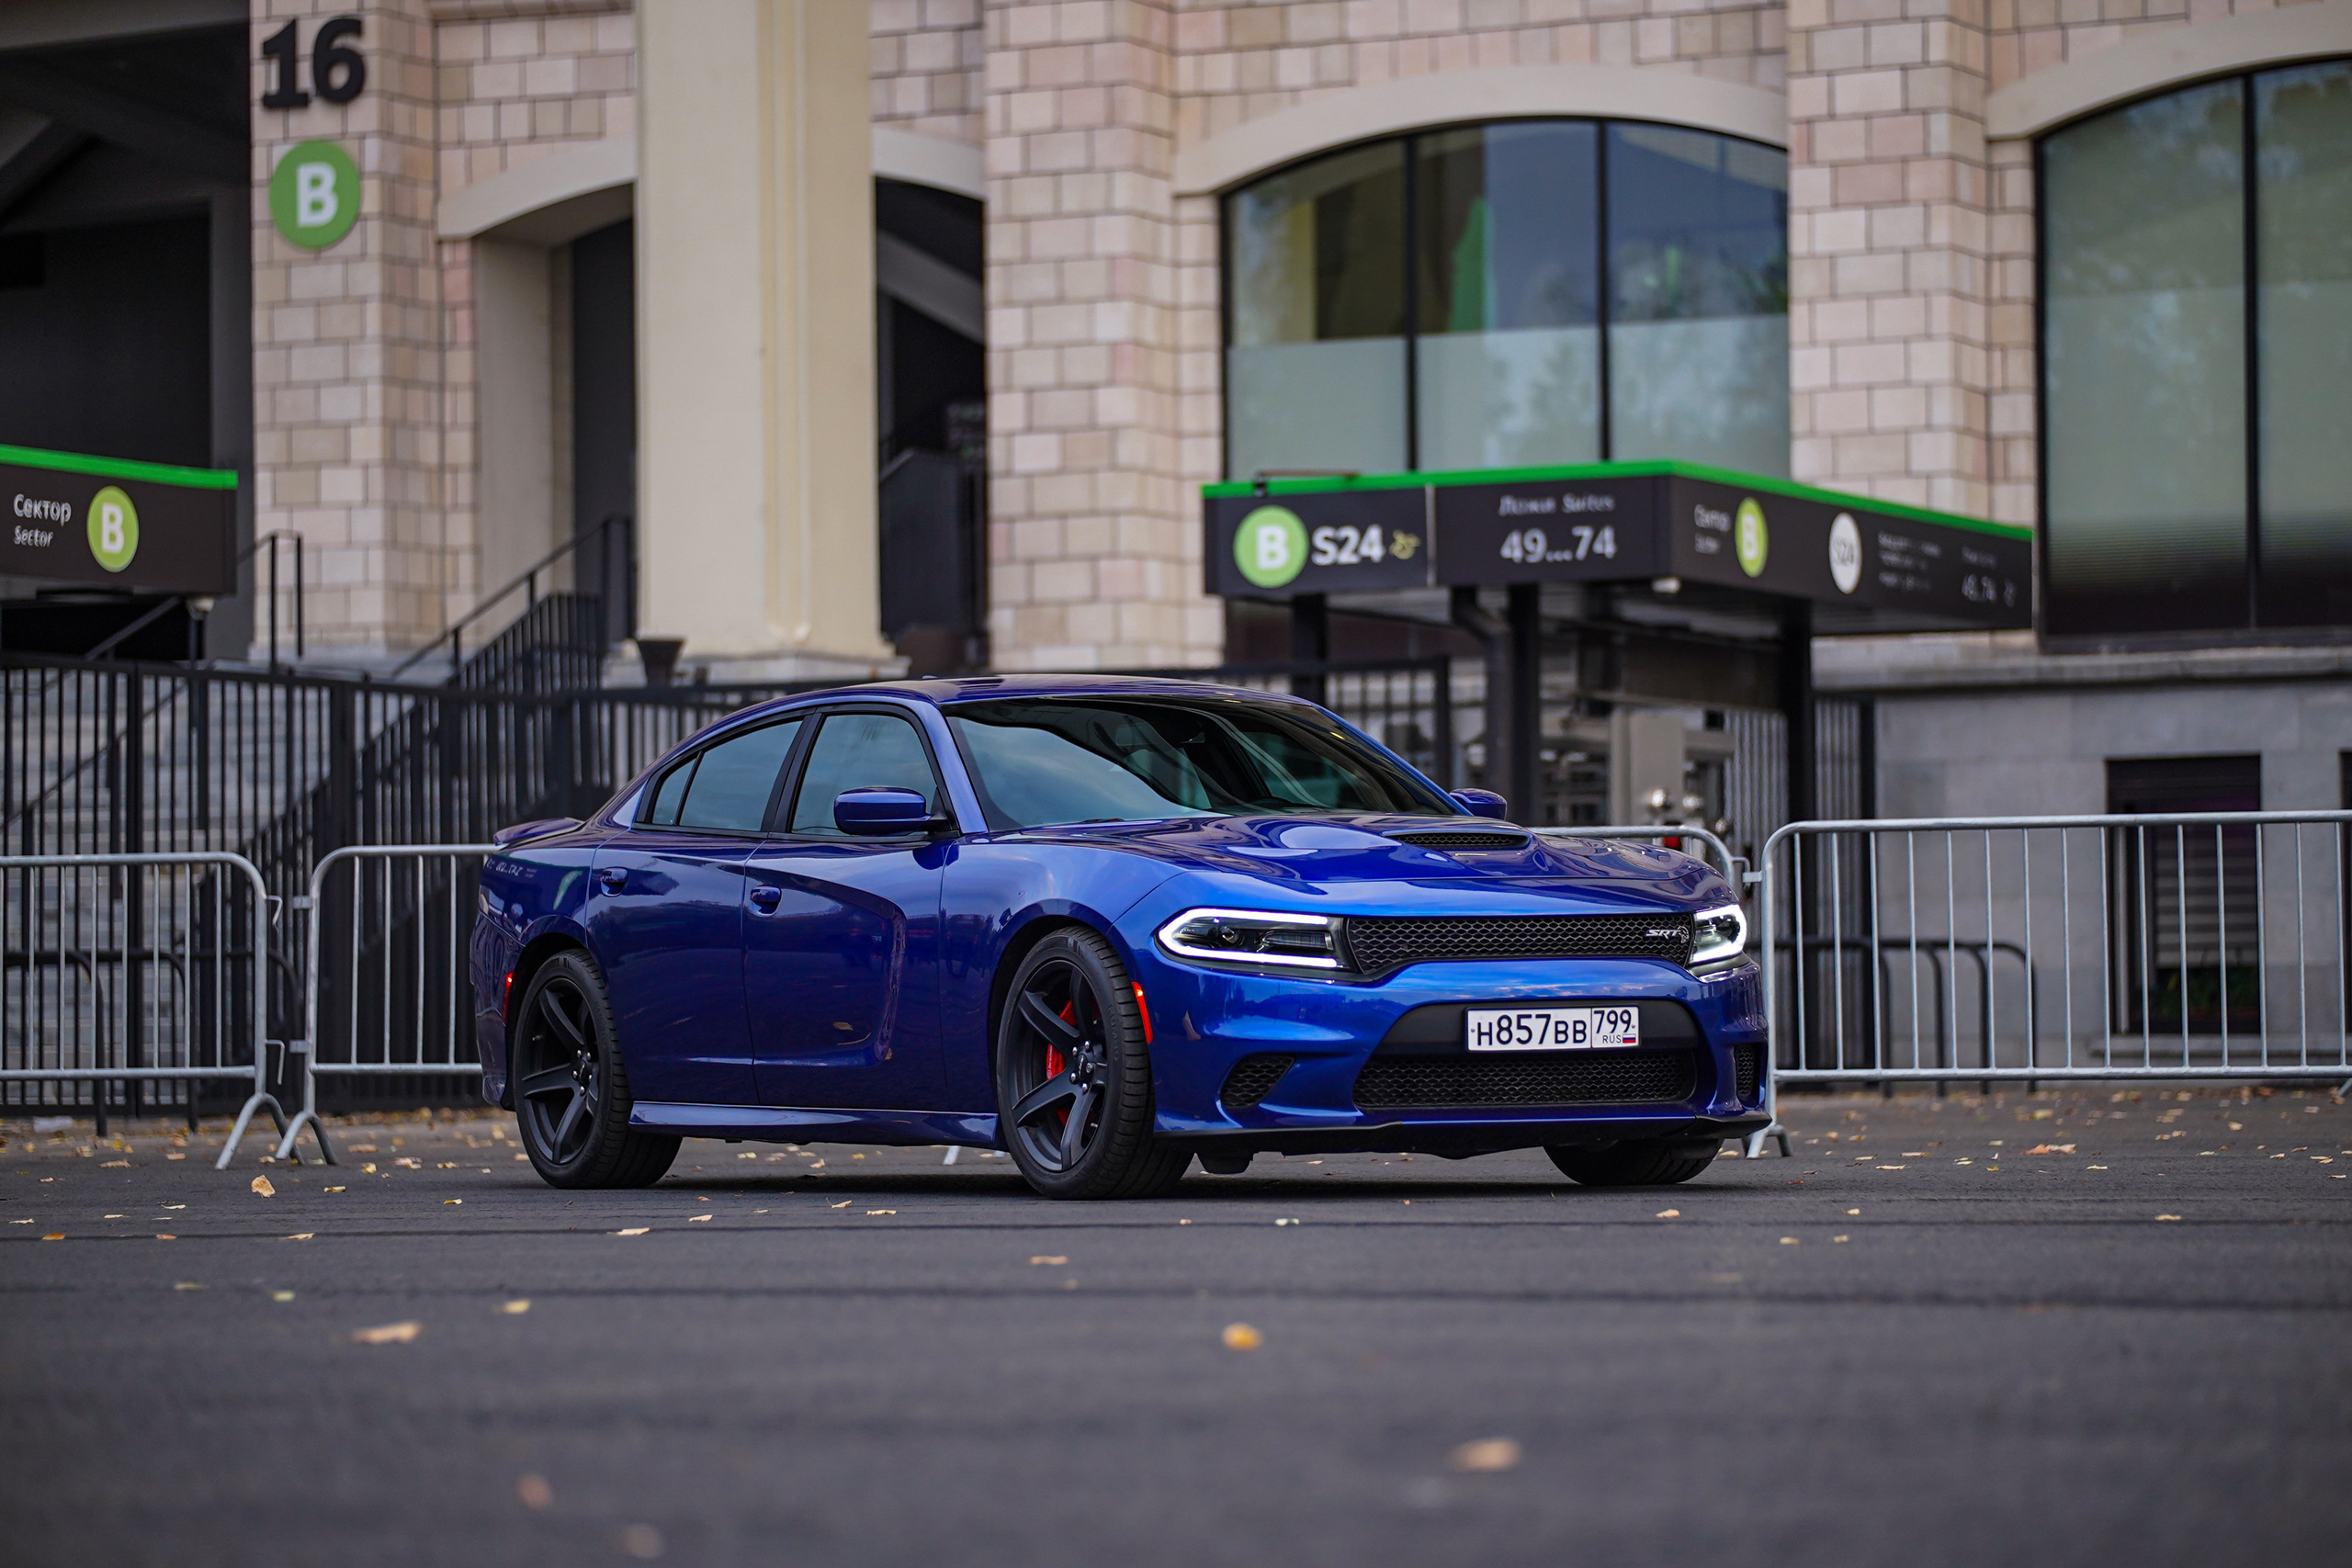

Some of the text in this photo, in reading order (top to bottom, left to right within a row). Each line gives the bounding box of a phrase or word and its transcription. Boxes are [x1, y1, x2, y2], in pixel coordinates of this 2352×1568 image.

[261, 16, 367, 109] 16
[296, 161, 339, 228] B
[13, 492, 72, 527] Сектор
[101, 502, 125, 554] B
[13, 525, 54, 548] Sector
[1255, 525, 1289, 570] B
[1311, 525, 1386, 566] S24
[1645, 929, 1681, 940] SRT
[1593, 1010, 1633, 1034] 799
[1602, 1034, 1622, 1043] RUS
